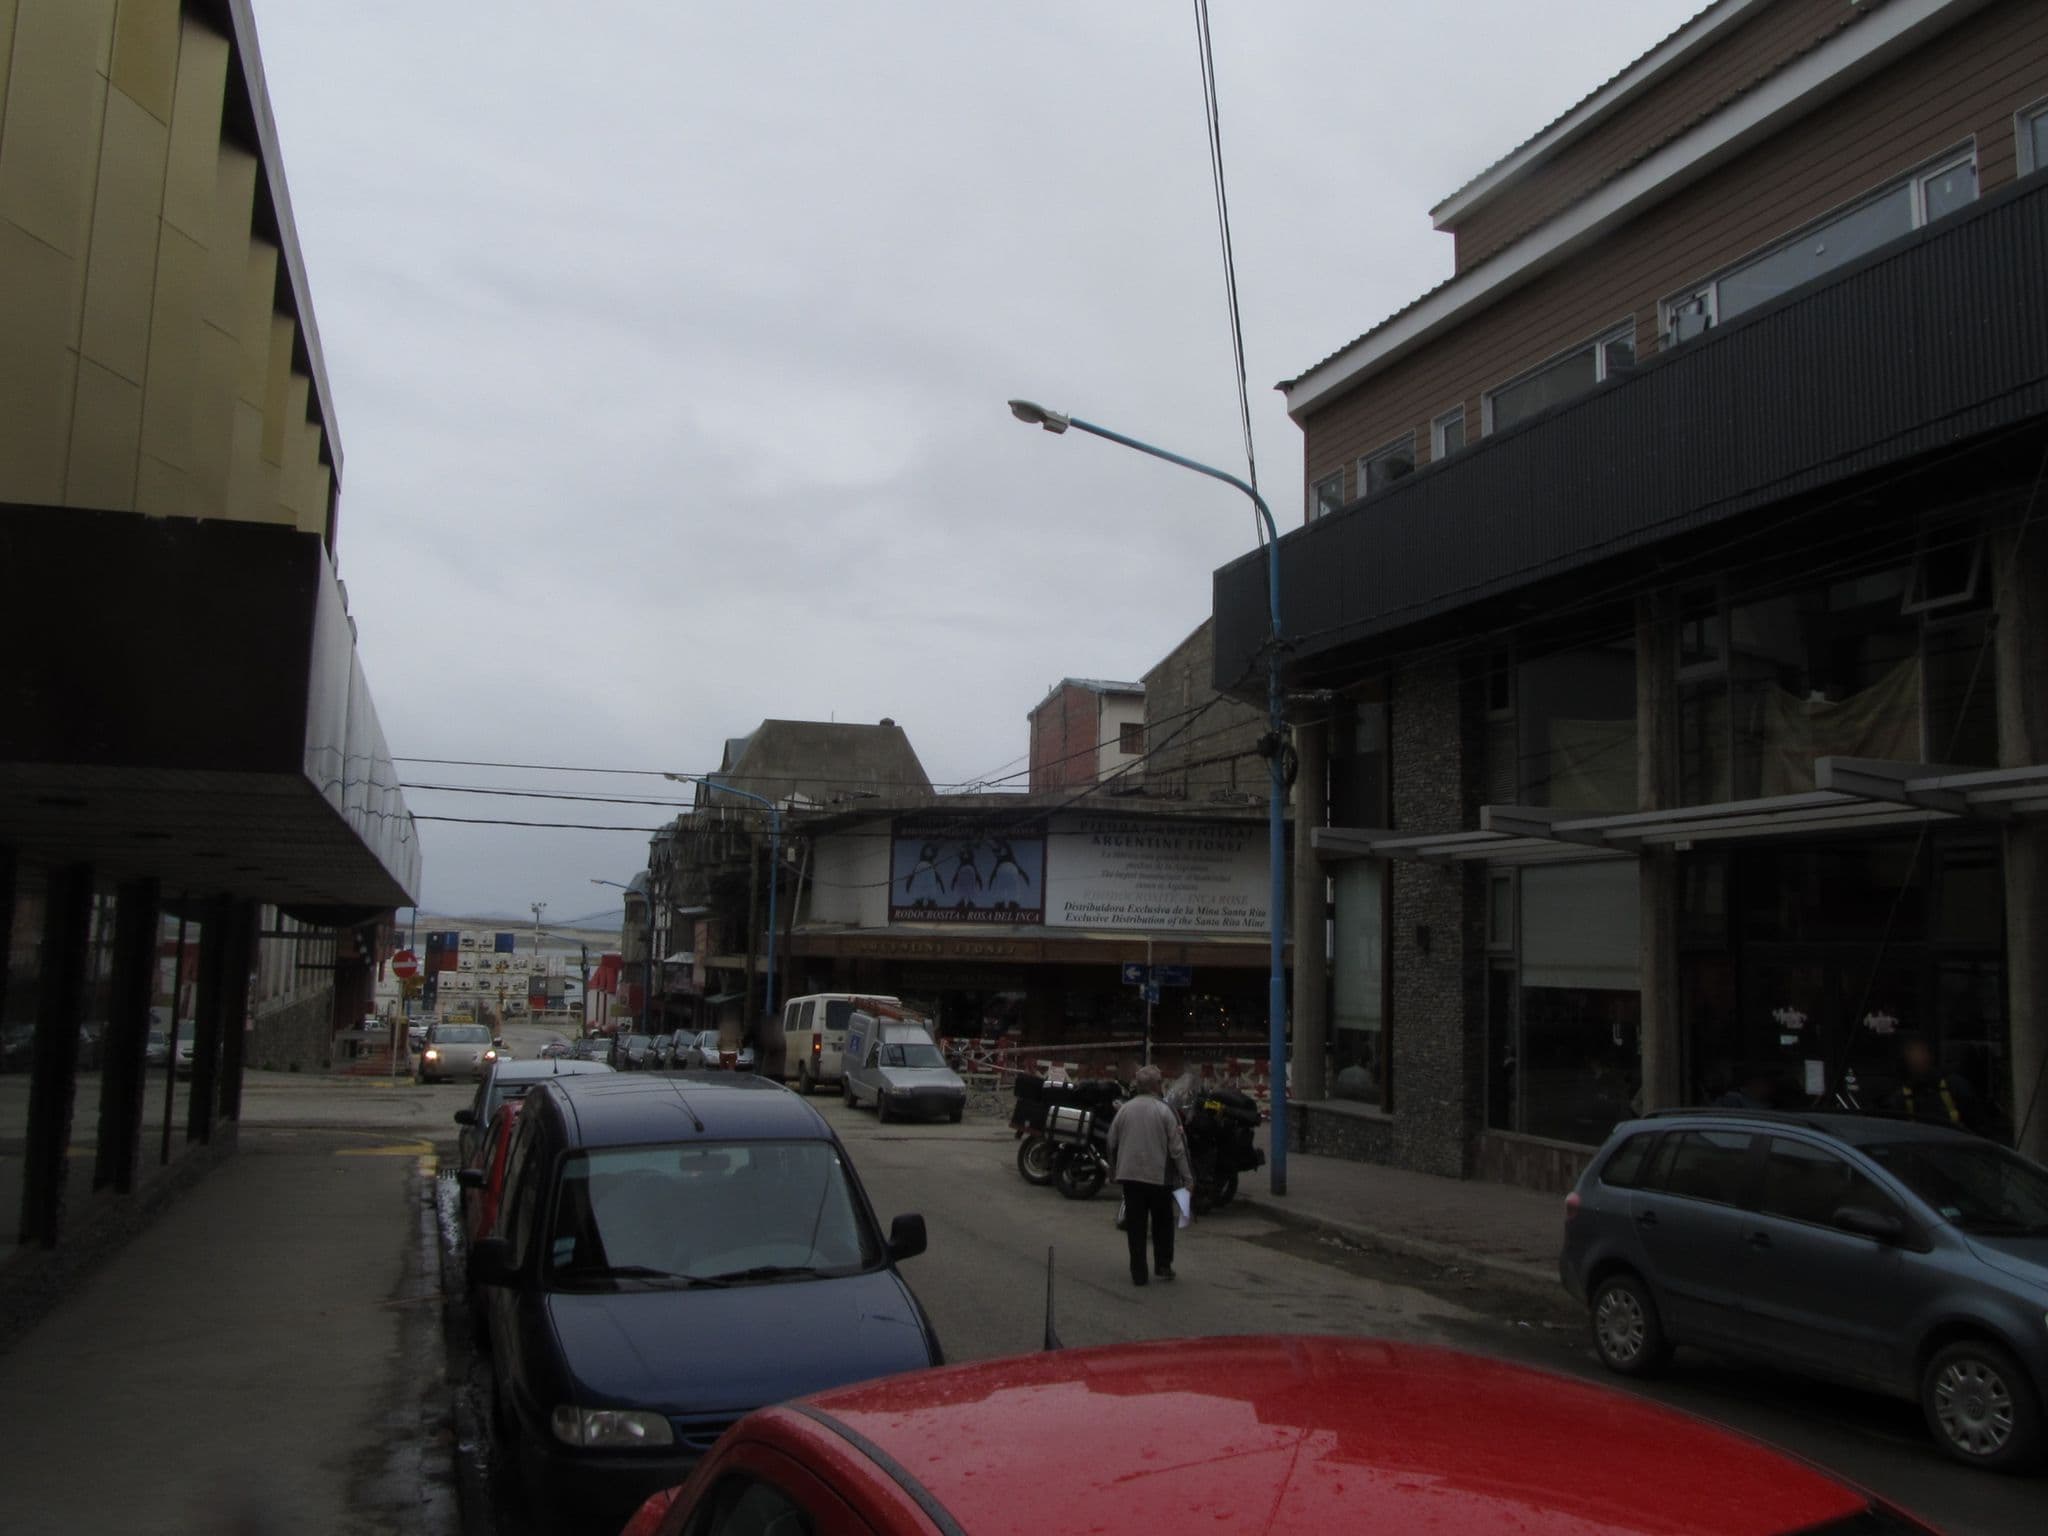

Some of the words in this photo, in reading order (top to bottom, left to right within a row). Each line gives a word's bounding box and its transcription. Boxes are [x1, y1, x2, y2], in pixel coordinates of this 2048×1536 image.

[894, 909, 960, 921] RODOCROSITA
[967, 910, 993, 922] ROSA
[994, 911, 1013, 922] DEL
[1014, 911, 1041, 922] INCA
[1127, 904, 1170, 914] Exclusiva
[1172, 906, 1183, 914] de
[1197, 906, 1219, 916] Mina
[1221, 907, 1246, 917] Santa
[1065, 913, 1109, 923] Exclusive
[1111, 914, 1165, 924] Distribution
[1194, 917, 1219, 927] Santa
[1242, 918, 1265, 928] Mine
